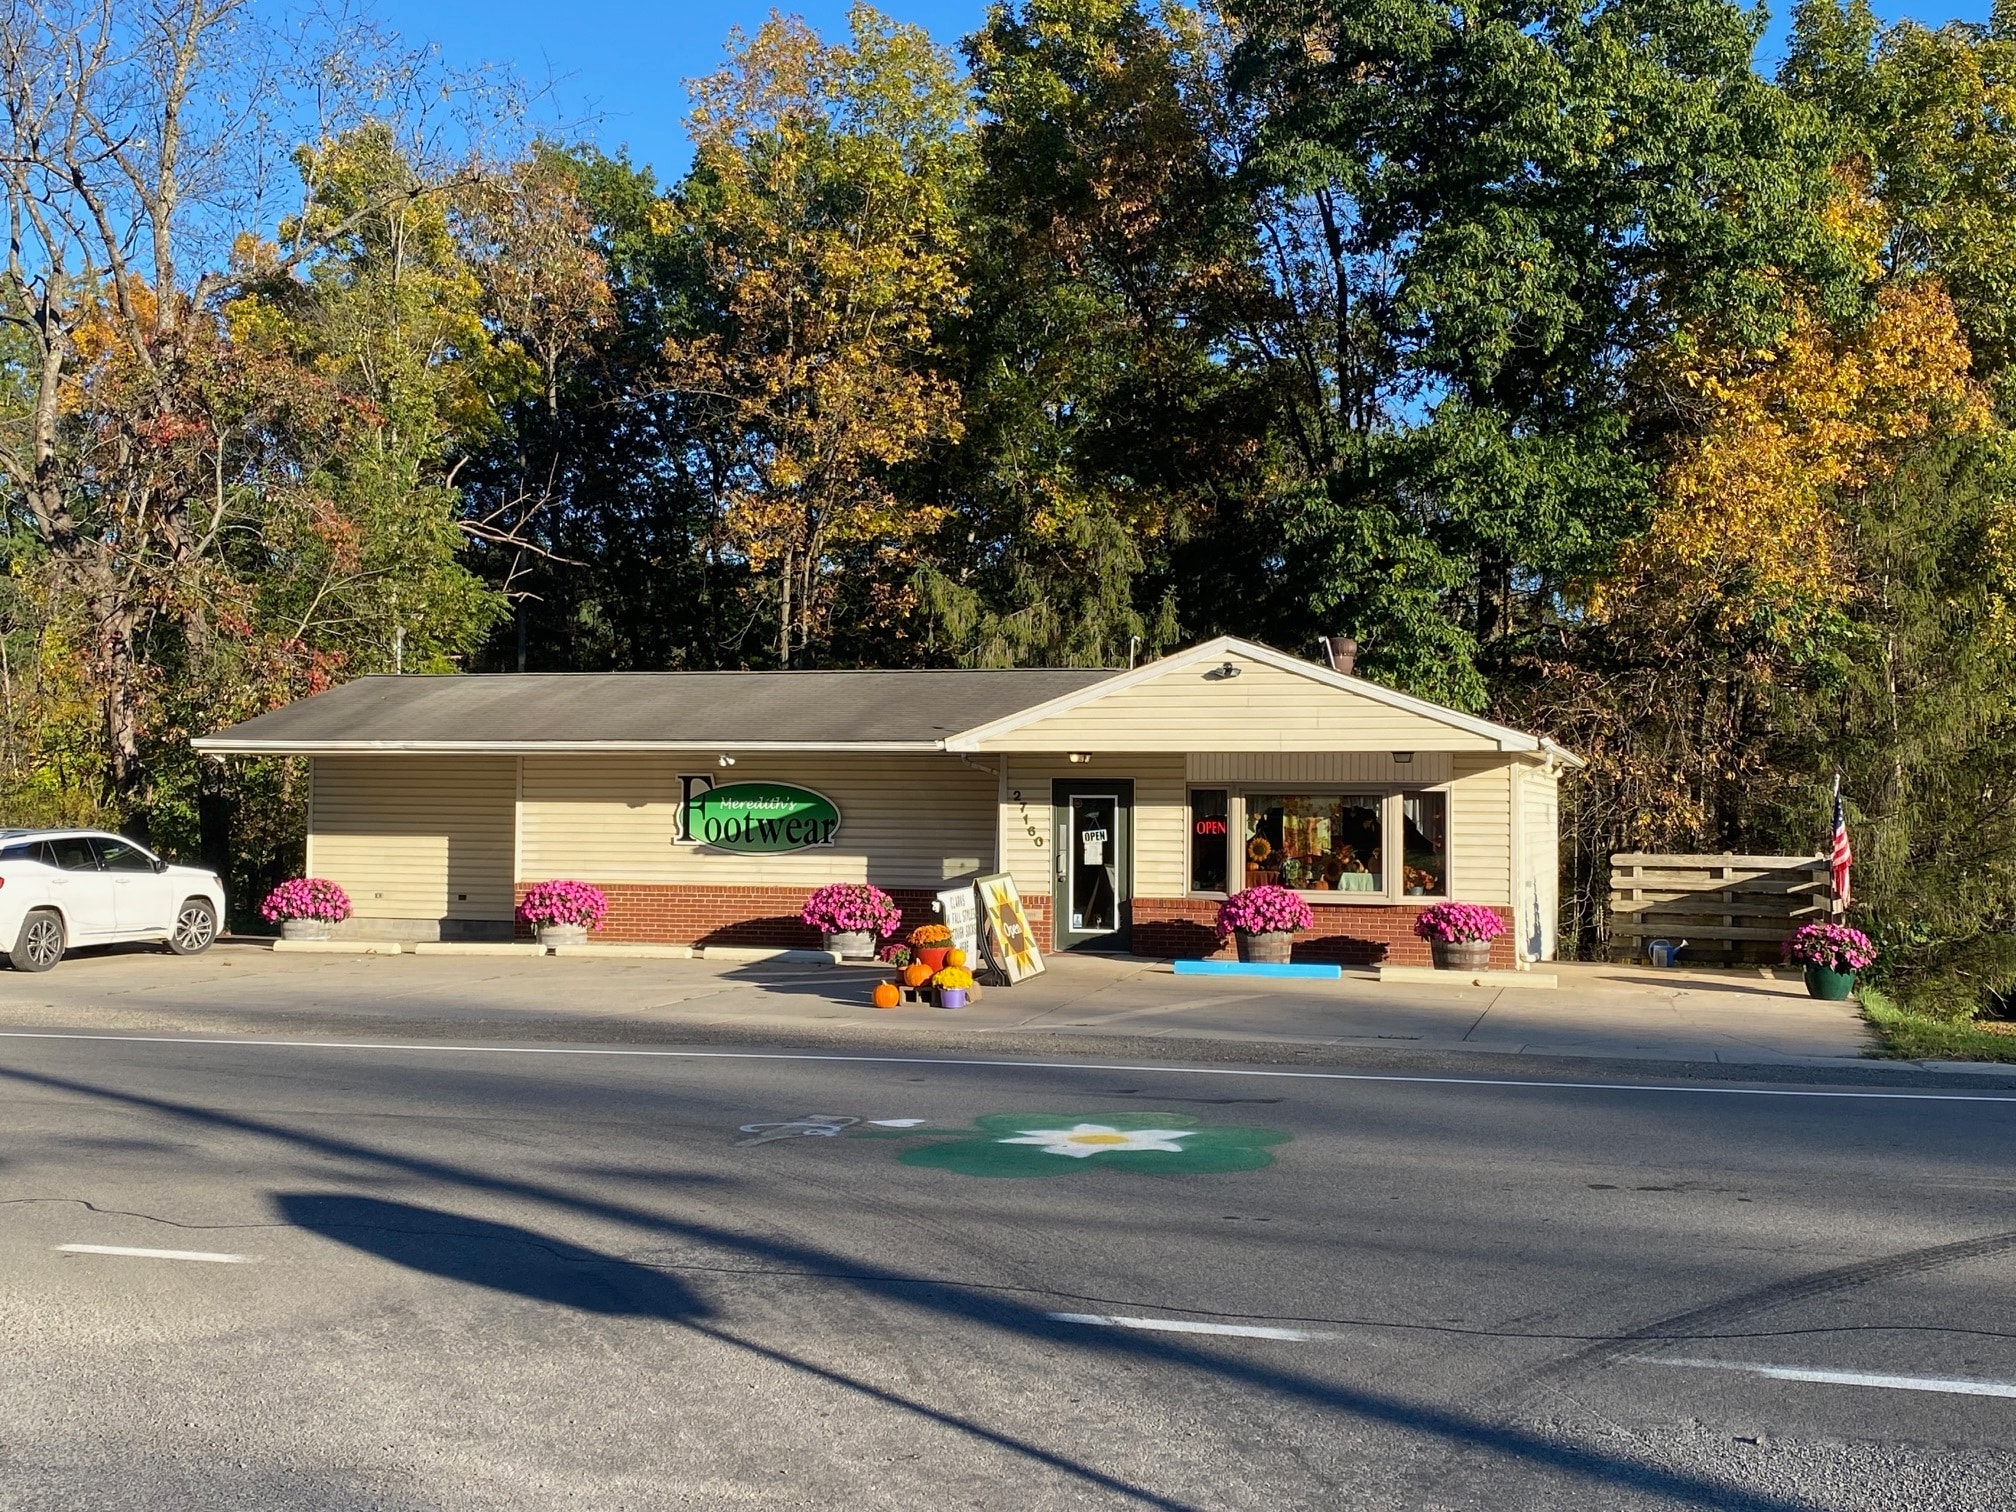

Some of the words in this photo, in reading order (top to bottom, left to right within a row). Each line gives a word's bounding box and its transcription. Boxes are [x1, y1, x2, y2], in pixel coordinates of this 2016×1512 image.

[677, 775, 836, 844] Footwear
[720, 797, 797, 811] Meredith's
[1013, 790, 1044, 847] 27160
[1196, 821, 1226, 835] OPEN
[1084, 831, 1106, 842] OPEN
[1003, 922, 1023, 939] Open
